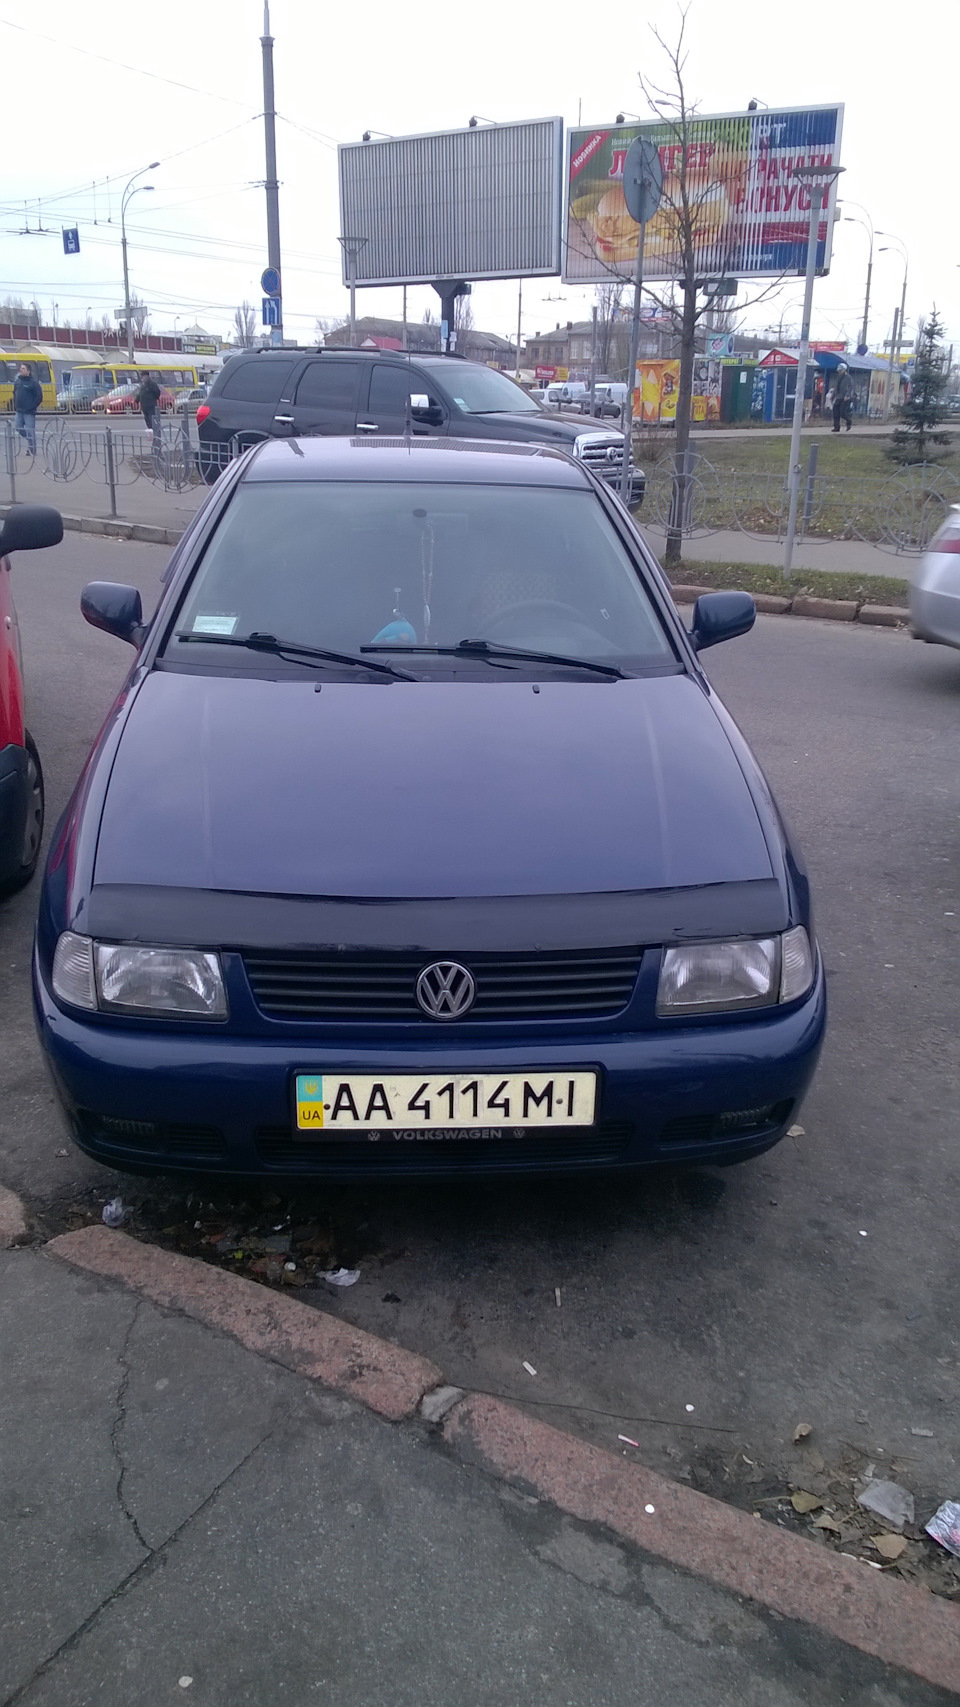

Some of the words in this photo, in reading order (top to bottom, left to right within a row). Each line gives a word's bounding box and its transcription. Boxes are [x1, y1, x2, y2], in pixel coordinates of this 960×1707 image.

[573, 135, 602, 168] НОВИНКА
[330, 1082, 394, 1121] AA
[407, 1080, 511, 1120] 4114
[522, 1080, 575, 1118] MI
[302, 1110, 321, 1121] UA
[392, 1128, 503, 1140] VOLKSWAGEN
